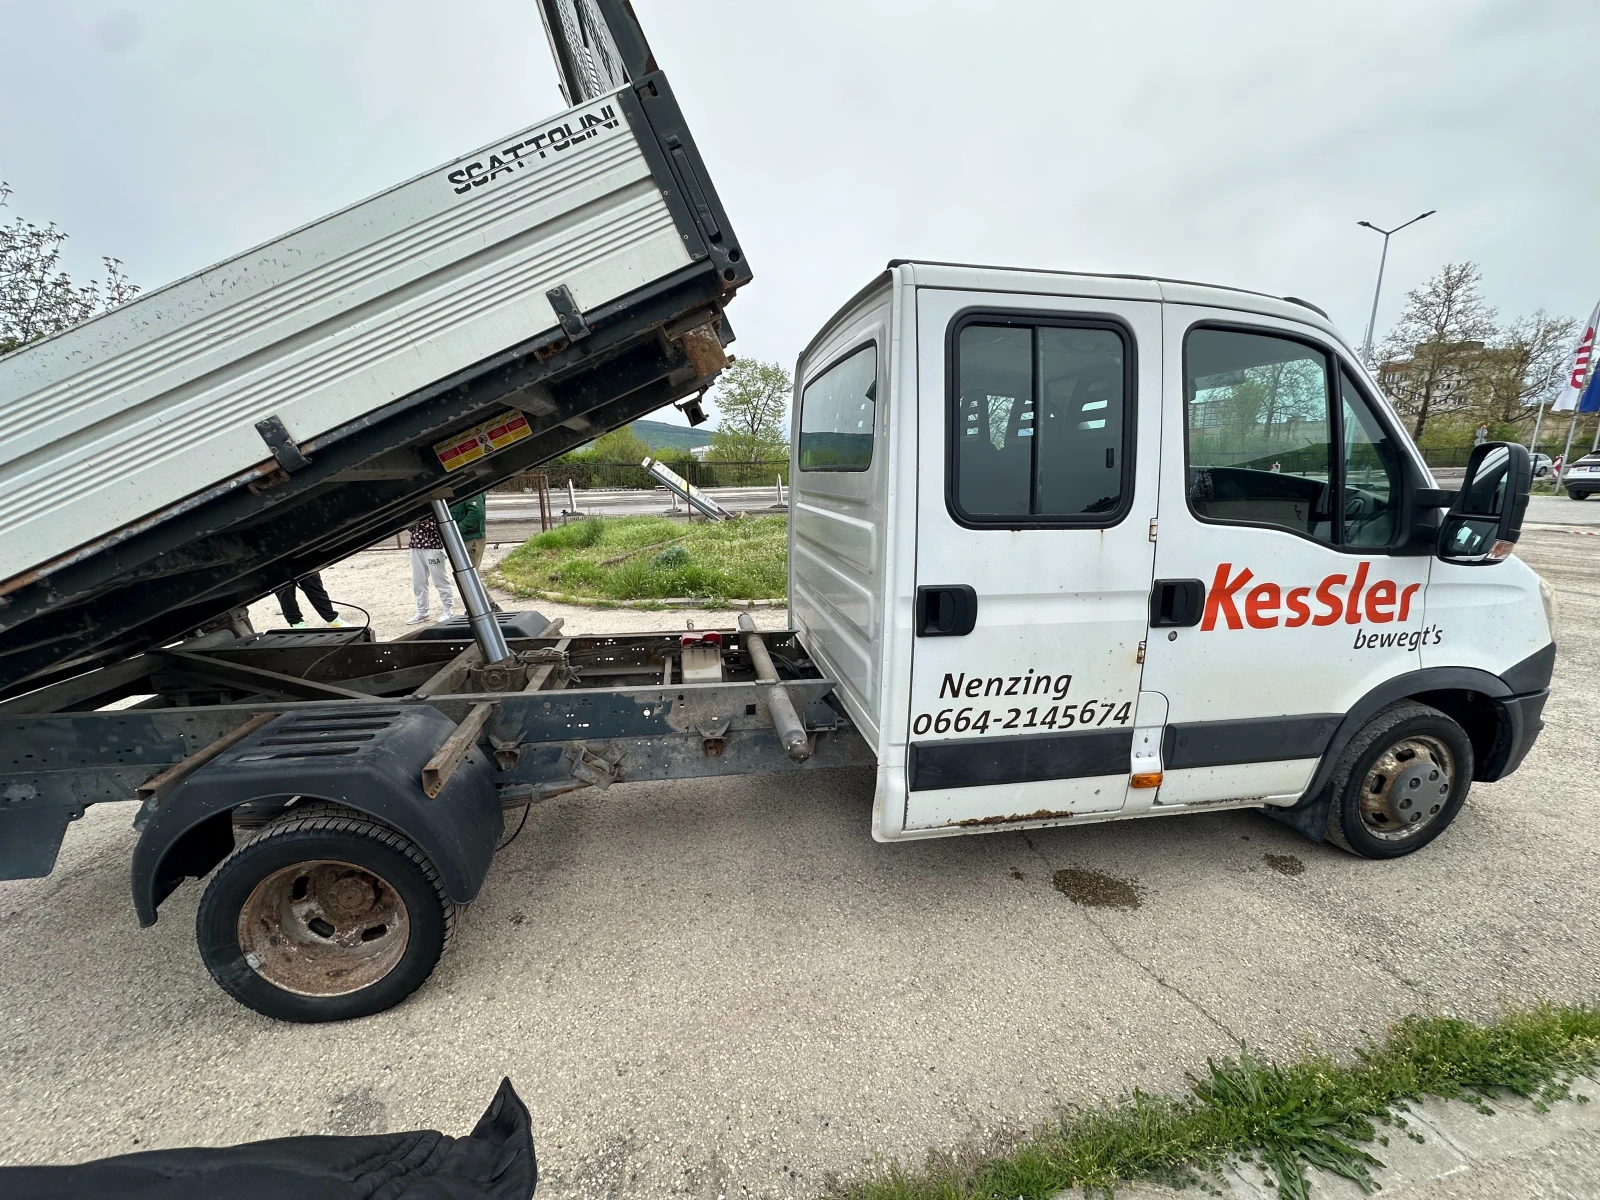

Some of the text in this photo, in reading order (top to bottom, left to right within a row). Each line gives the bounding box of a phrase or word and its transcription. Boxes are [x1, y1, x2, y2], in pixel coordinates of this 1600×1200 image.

[447, 104, 620, 194] SCATTOLINI
[1353, 624, 1443, 652] bewegt's
[939, 668, 1073, 701] Nenzing
[912, 699, 1132, 735] 0664-2145674
